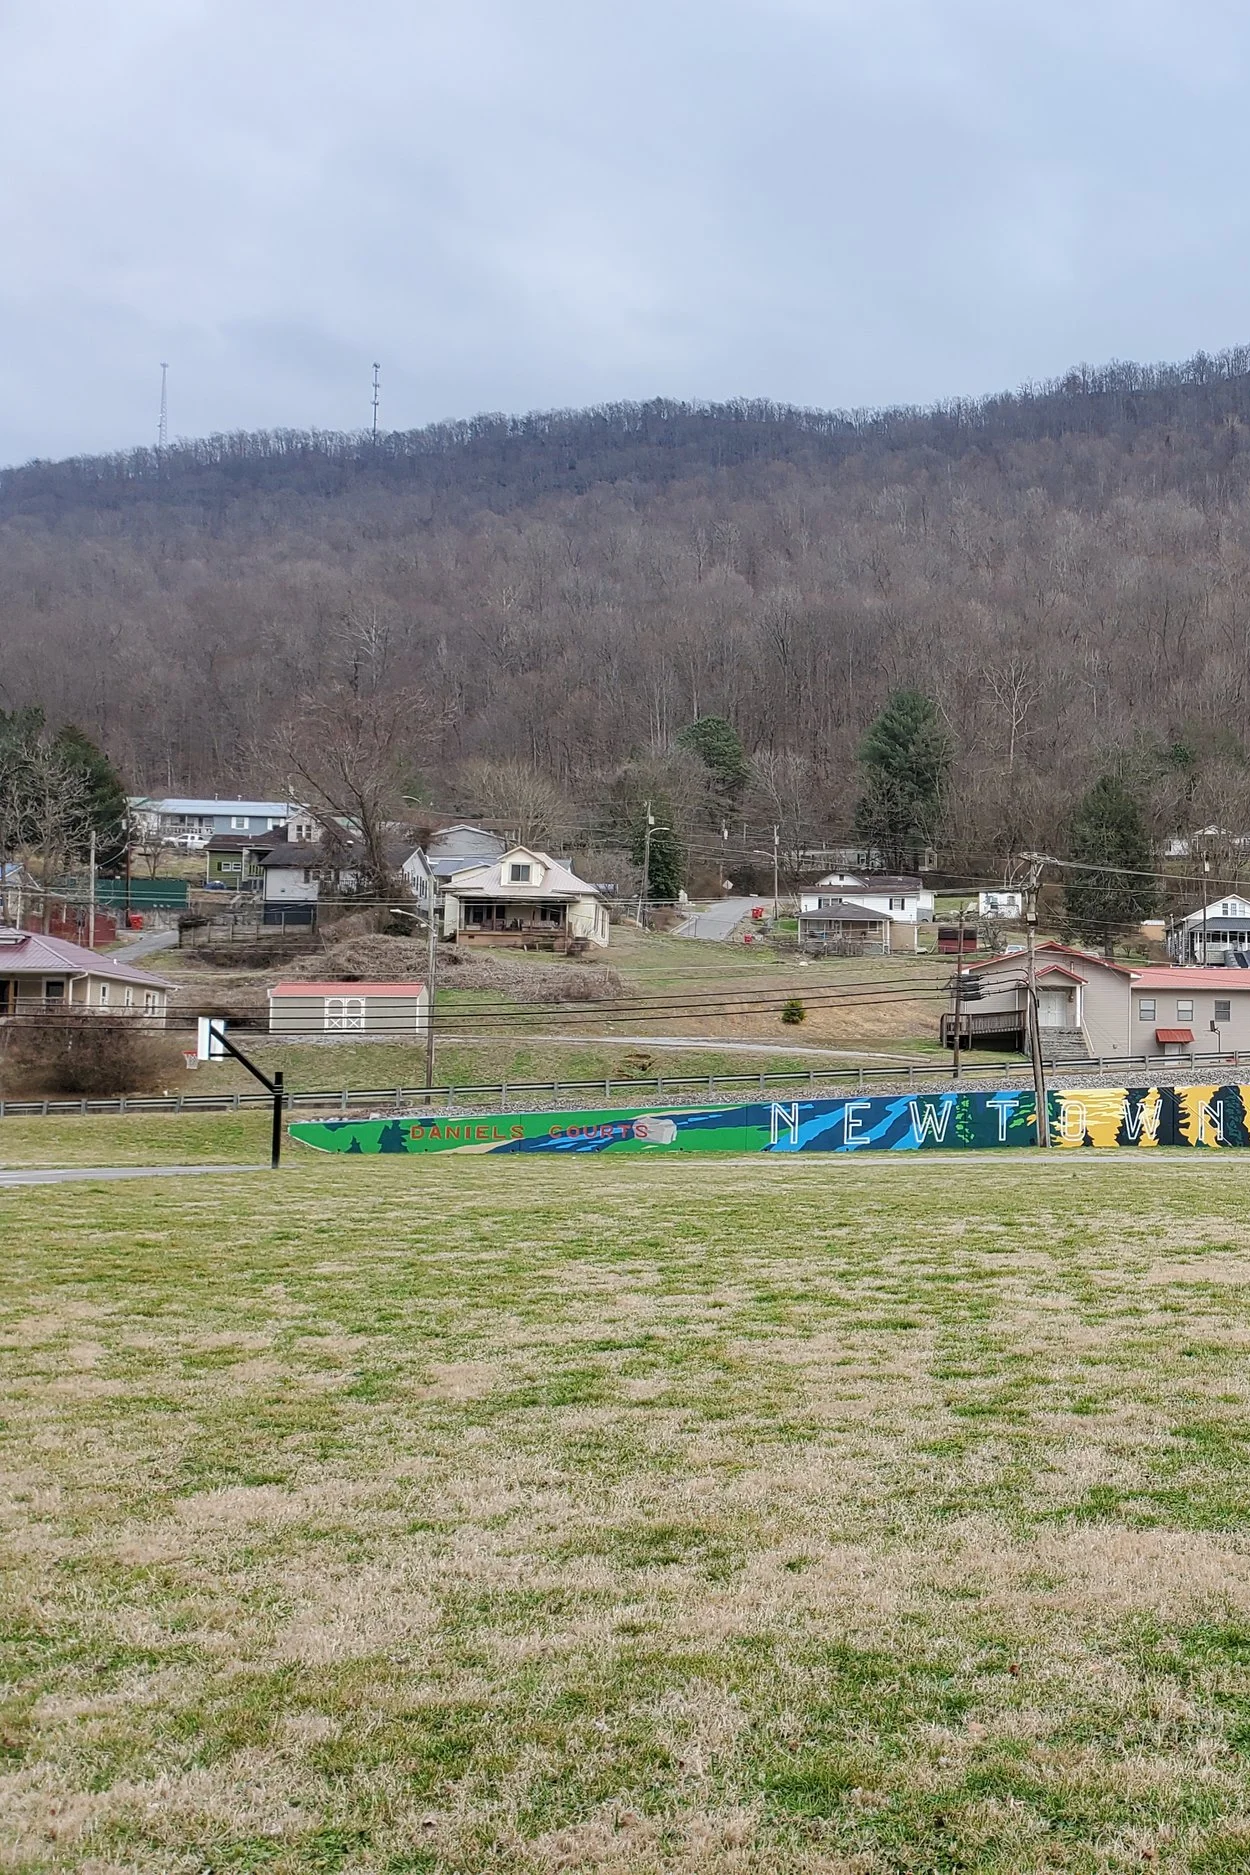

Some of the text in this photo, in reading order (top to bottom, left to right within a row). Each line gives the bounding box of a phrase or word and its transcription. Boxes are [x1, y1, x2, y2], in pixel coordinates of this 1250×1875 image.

[410, 1124, 649, 1140] DANIELS COURTS
[770, 1098, 1224, 1145] NEWTOWN
